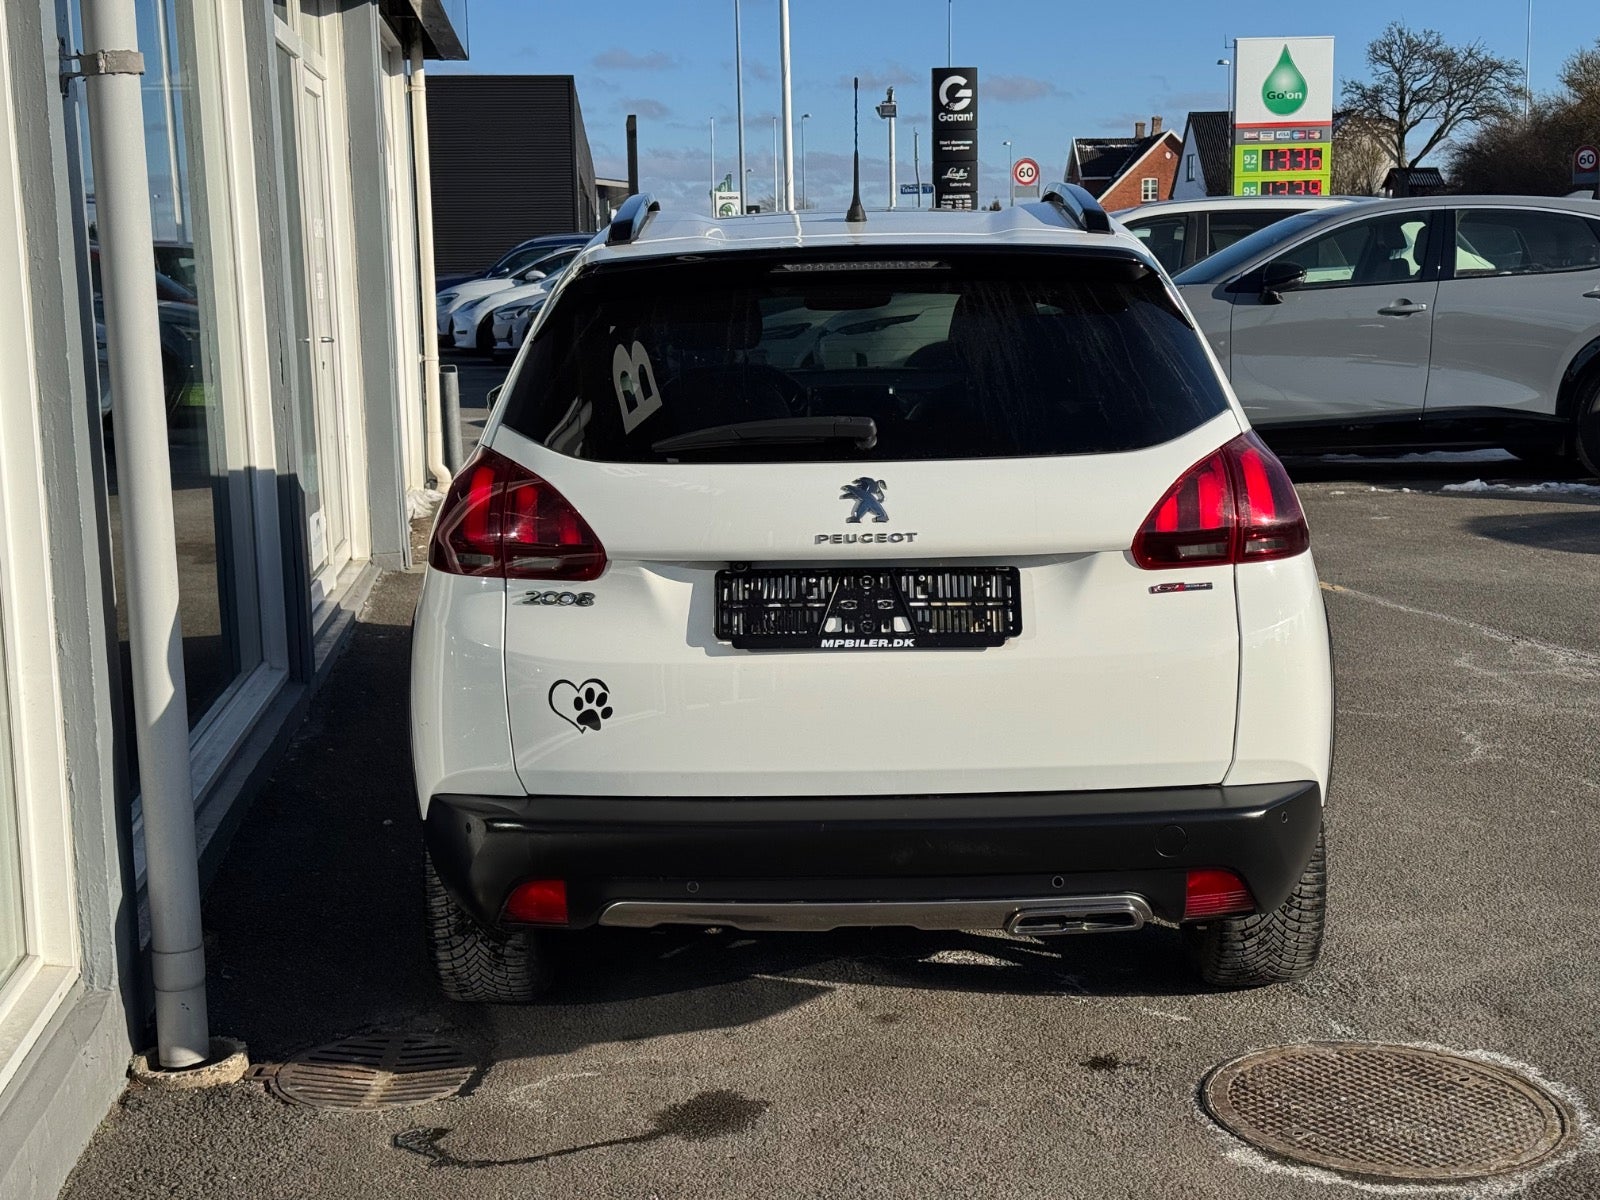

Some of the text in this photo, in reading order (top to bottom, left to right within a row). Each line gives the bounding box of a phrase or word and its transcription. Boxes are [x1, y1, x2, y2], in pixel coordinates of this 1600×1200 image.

[1266, 91, 1302, 100] Go'on
[938, 112, 973, 121] Garant
[1244, 155, 1257, 164] 92
[1579, 154, 1595, 165] 60
[1019, 167, 1034, 178] 60
[814, 532, 918, 545] PEUGEOT
[521, 590, 596, 607] 2008
[820, 638, 916, 648] MPBILER.DK
